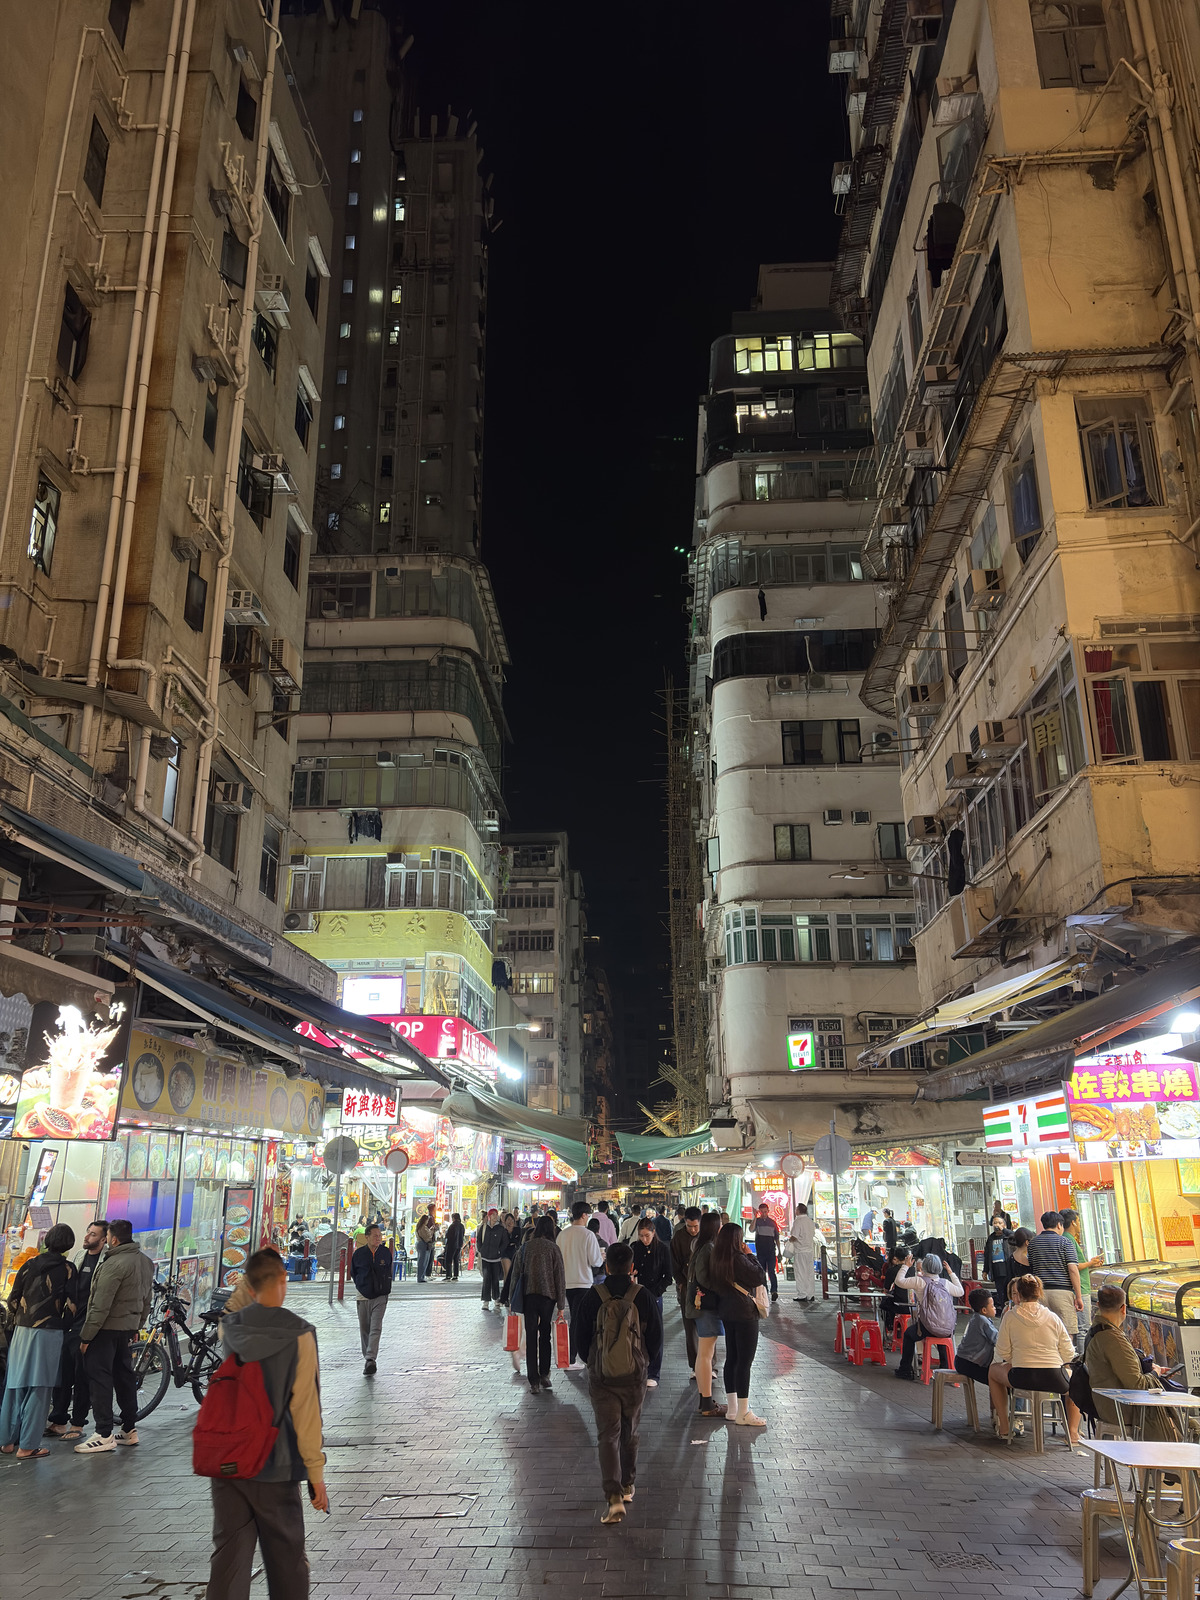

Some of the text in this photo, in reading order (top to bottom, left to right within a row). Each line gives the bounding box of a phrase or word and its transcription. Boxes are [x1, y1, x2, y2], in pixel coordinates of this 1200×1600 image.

[792, 1022, 813, 1031] 6212
[819, 1021, 840, 1031] 4550
[1069, 1068, 1194, 1100] 佐敦串燒
[344, 1094, 397, 1118] 新興粉麵
[516, 1154, 544, 1162] 成人用品
